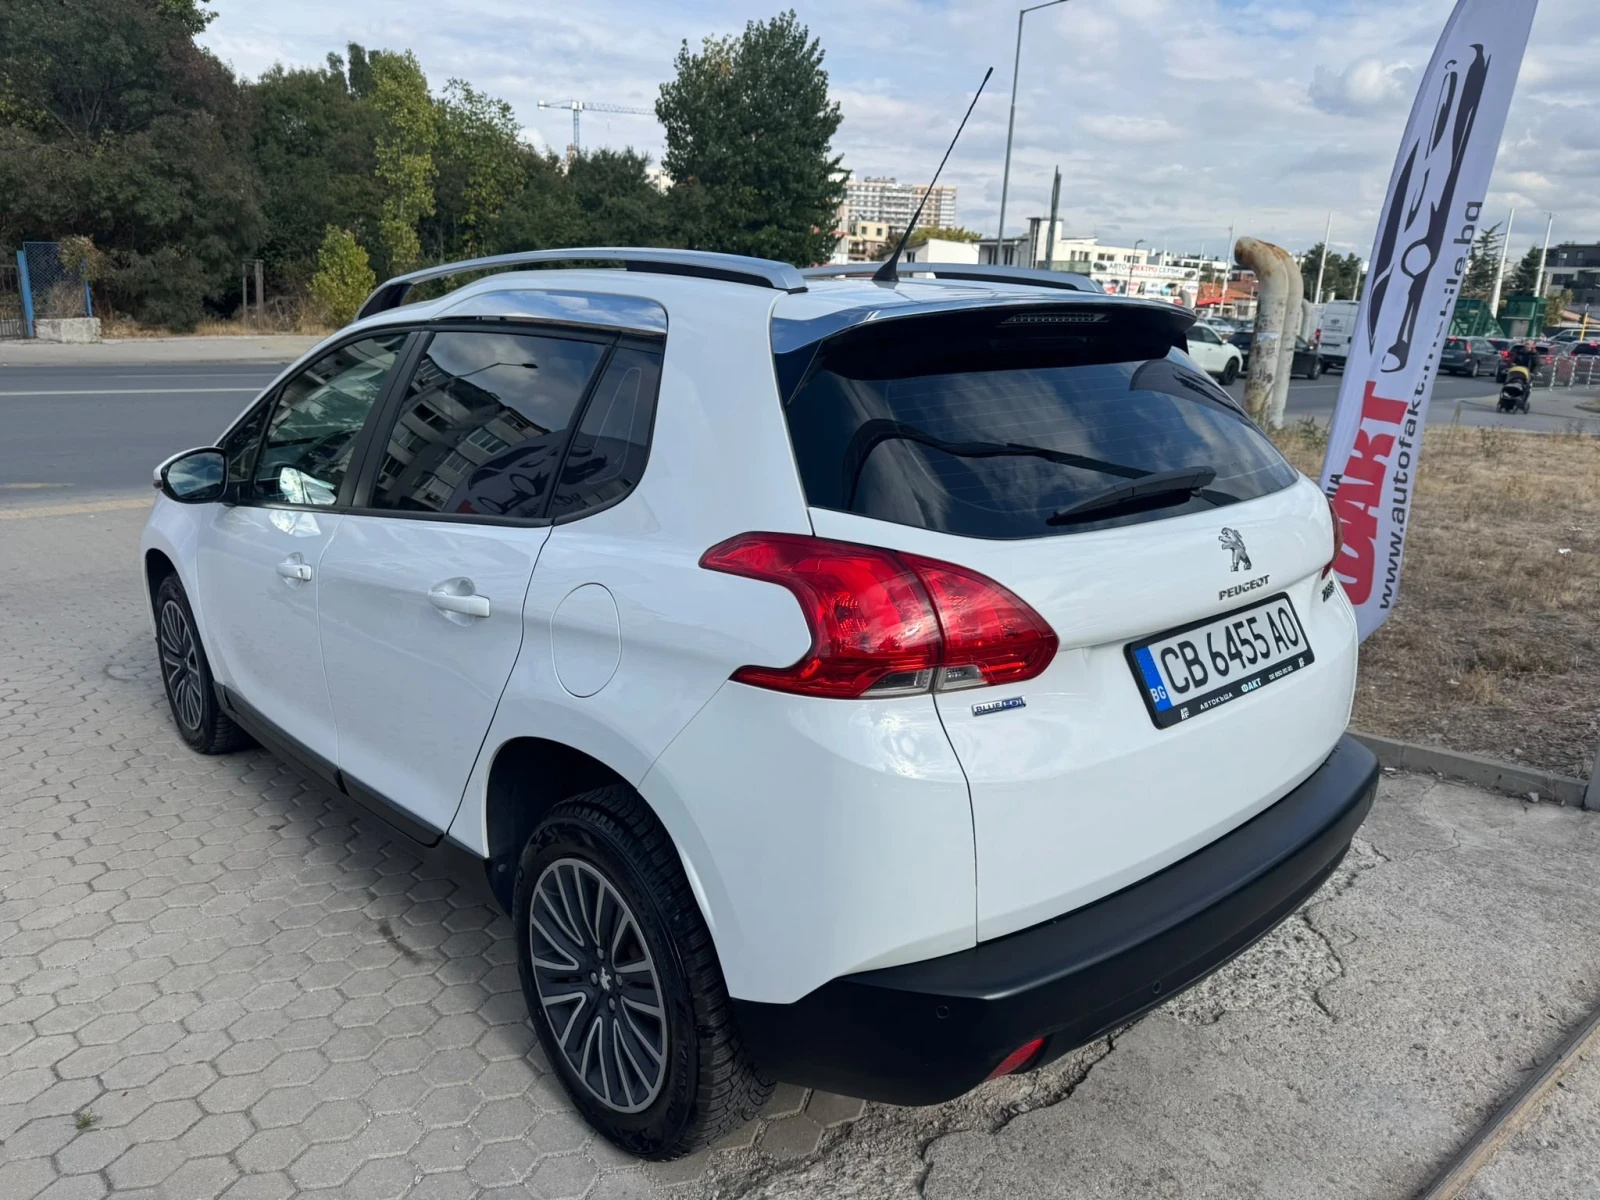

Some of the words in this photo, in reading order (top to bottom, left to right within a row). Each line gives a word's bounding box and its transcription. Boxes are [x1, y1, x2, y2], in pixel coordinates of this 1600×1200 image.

[1219, 574, 1270, 601] PEUGEOT
[1160, 640, 1209, 694] CB
[1206, 616, 1271, 677] 6455
[1150, 685, 1167, 703] BG
[1241, 678, 1262, 693] ФАКТ
